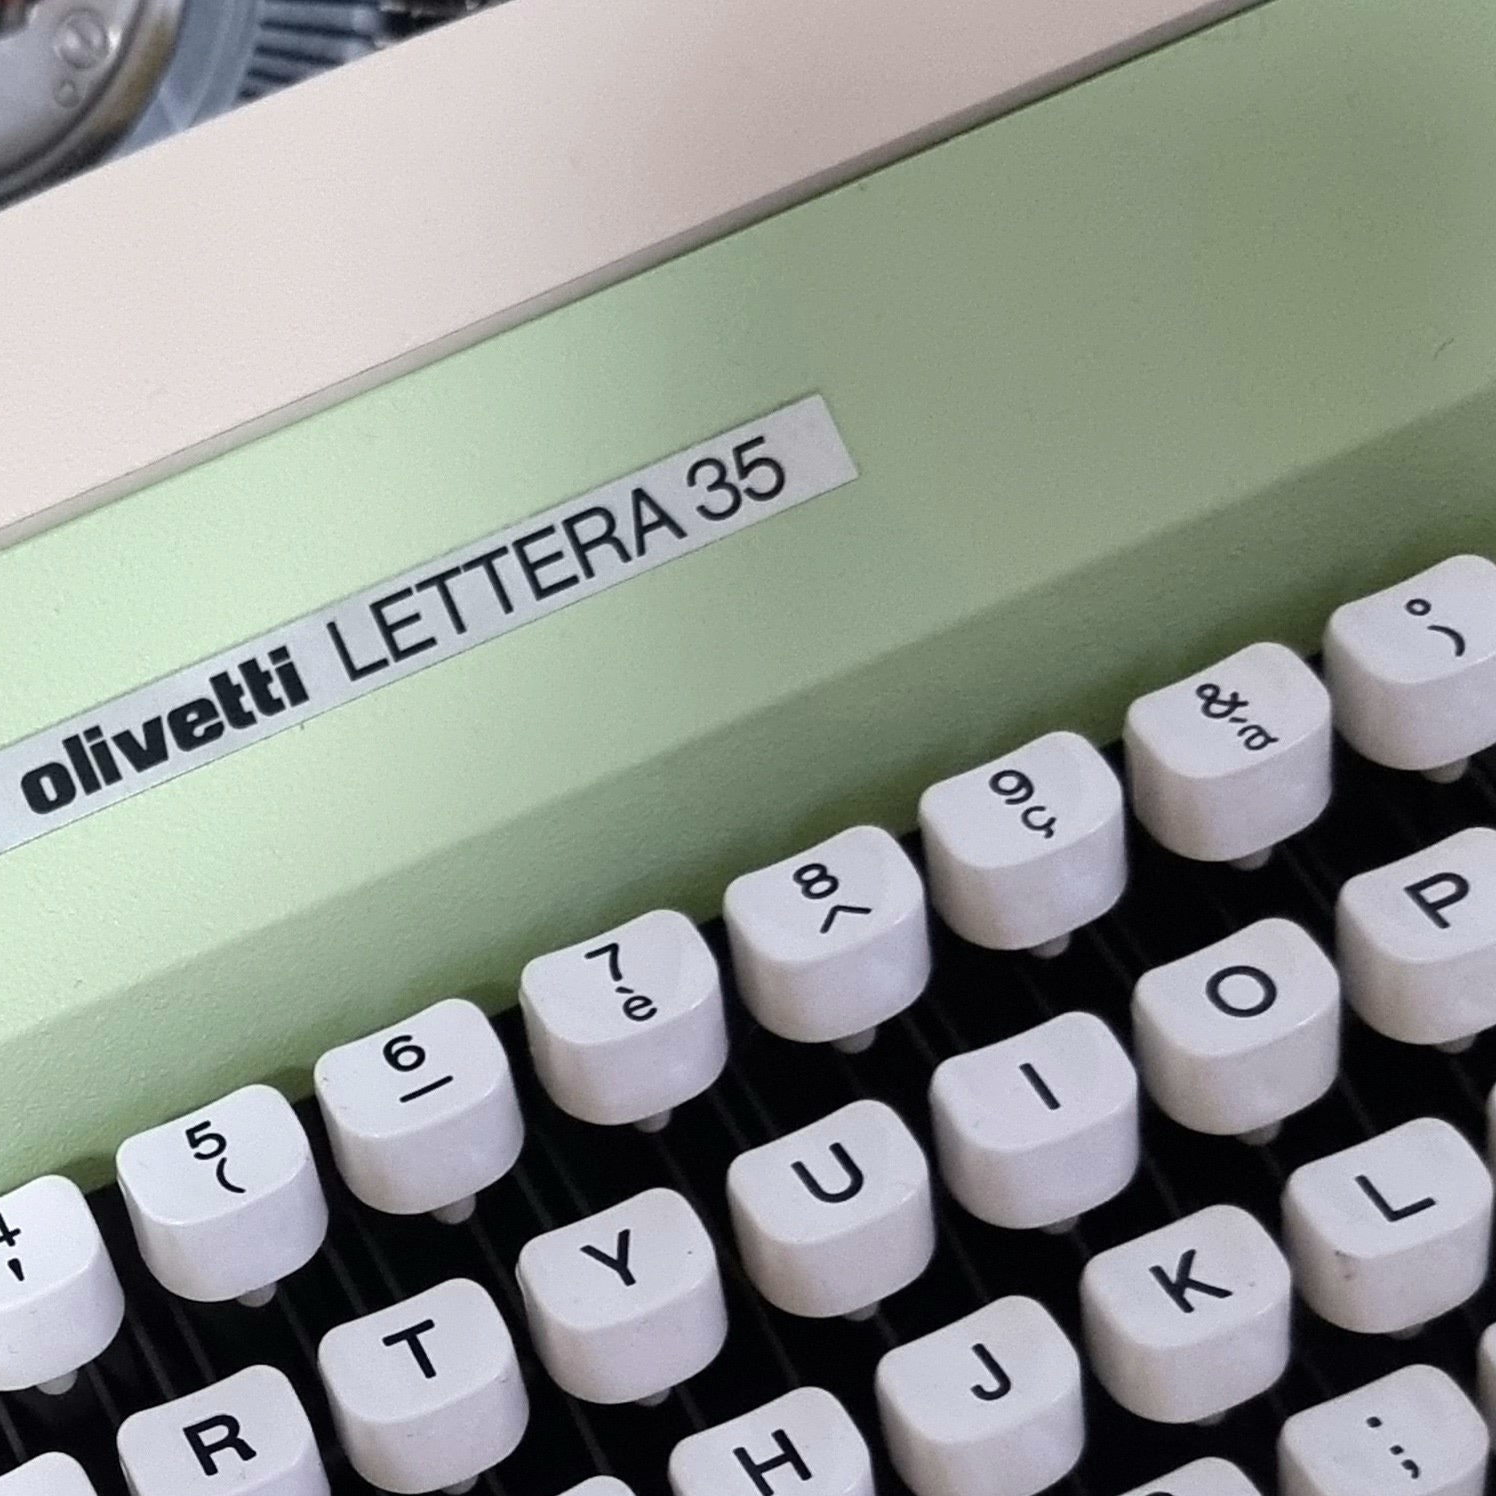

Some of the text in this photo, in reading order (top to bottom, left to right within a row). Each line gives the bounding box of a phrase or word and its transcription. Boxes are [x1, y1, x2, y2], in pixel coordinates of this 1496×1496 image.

[20, 435, 787, 815] olivetti LETTERA 35
[1196, 684, 1249, 719] &
[989, 770, 1034, 805] 9
[1022, 806, 1056, 838] ç
[793, 863, 839, 899] 8
[1404, 873, 1469, 929] P
[585, 943, 621, 982] 7
[1206, 966, 1277, 1017] O
[383, 1035, 425, 1072] 6
[1020, 1063, 1060, 1110] I
[186, 1121, 226, 1160] 5
[791, 1143, 864, 1203] U
[1355, 1175, 1436, 1222] L
[580, 1229, 636, 1286] Y
[1149, 1249, 1233, 1313] K
[382, 1319, 436, 1378] T
[971, 1344, 1011, 1401] J
[183, 1414, 256, 1476] R
[733, 1429, 812, 1496] H
